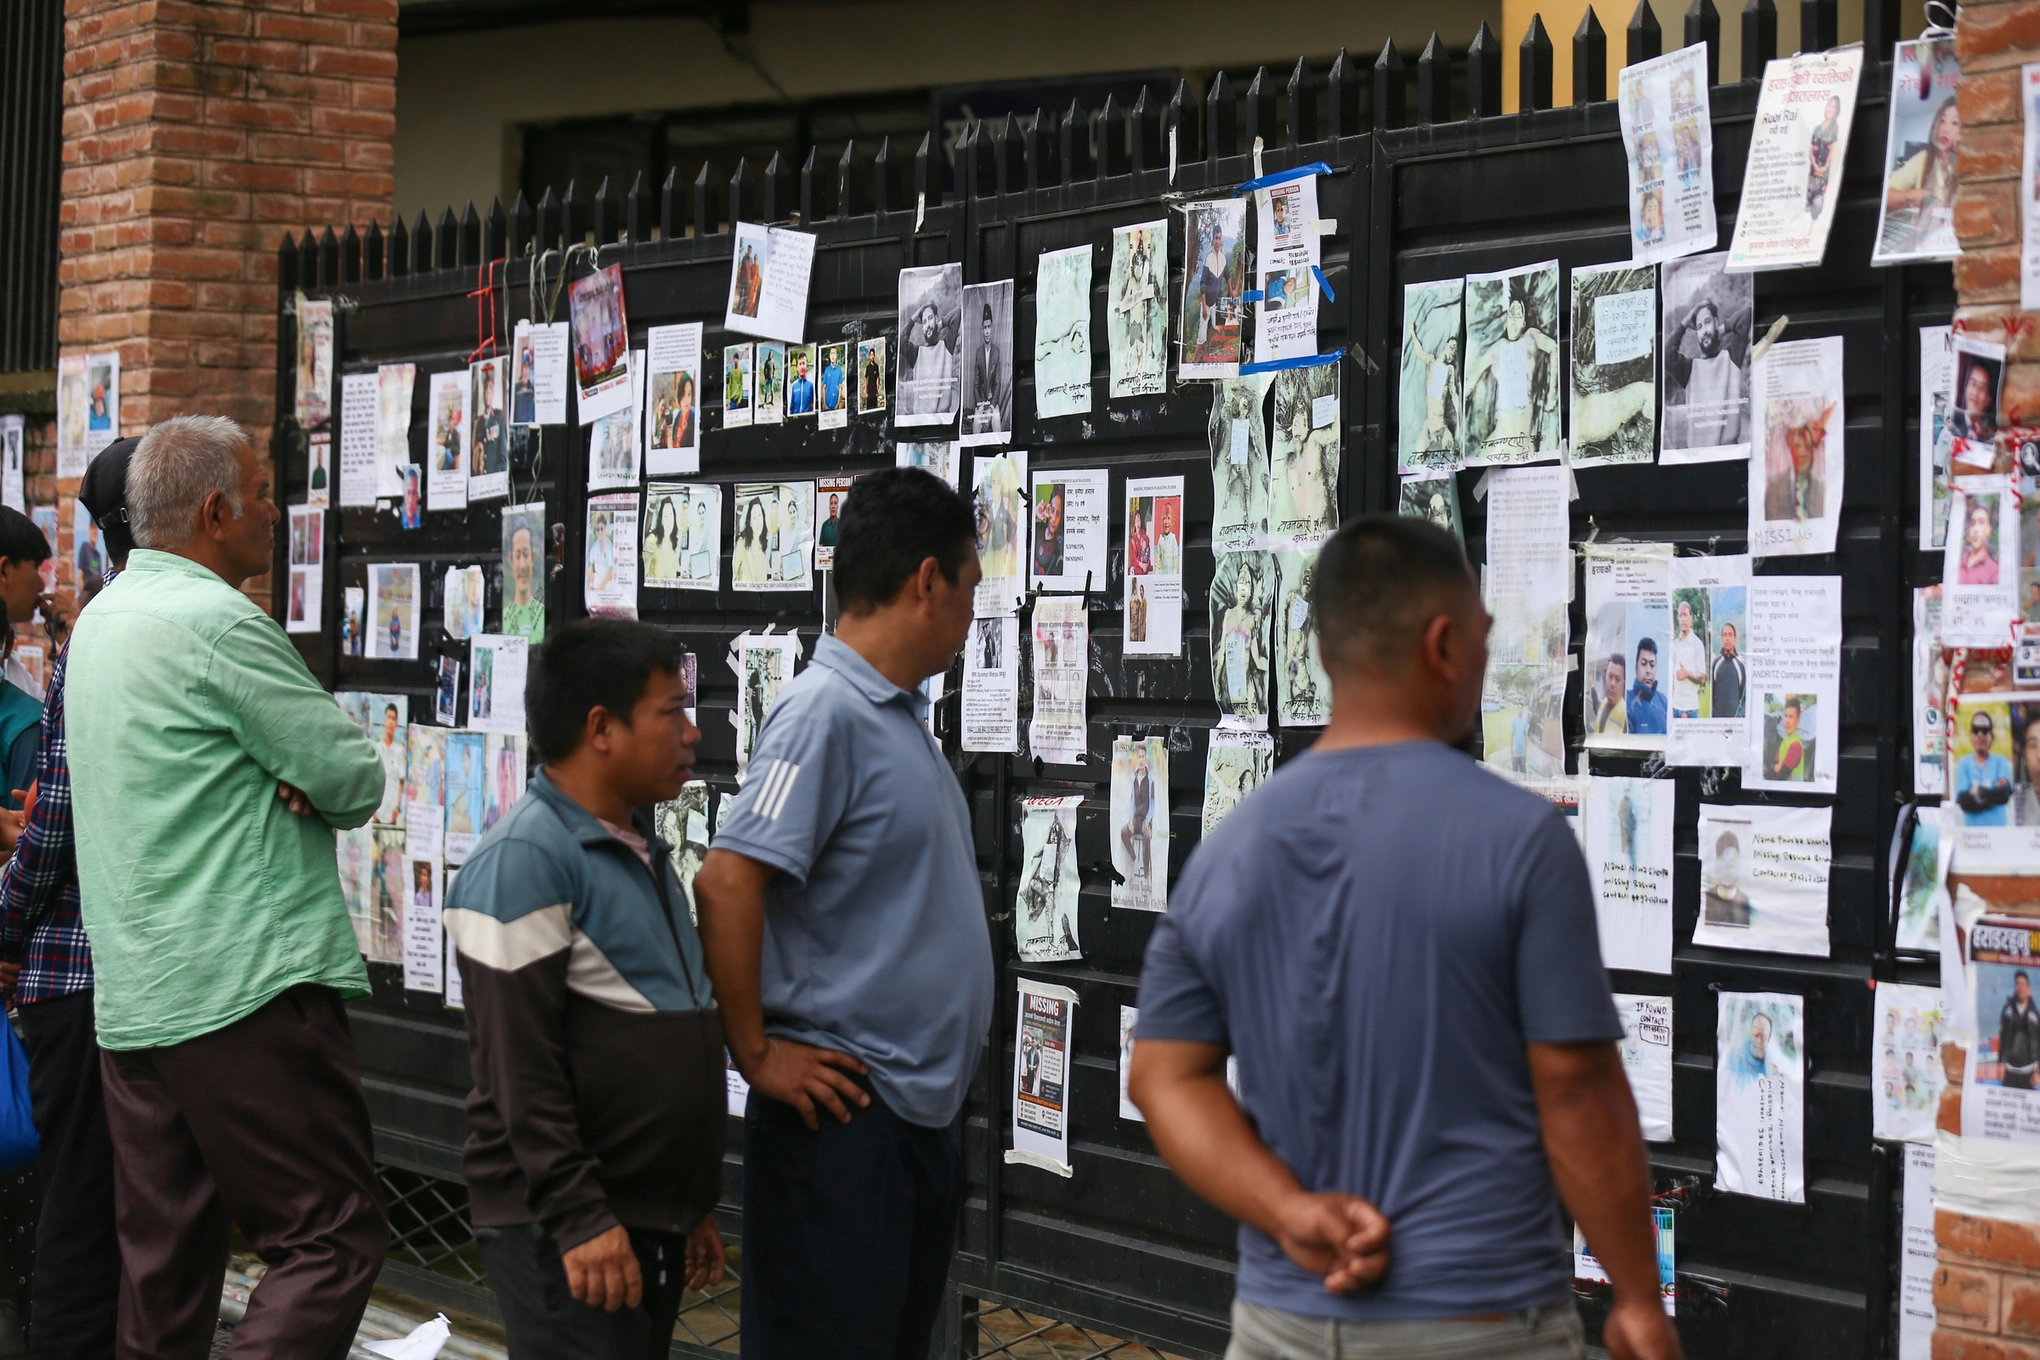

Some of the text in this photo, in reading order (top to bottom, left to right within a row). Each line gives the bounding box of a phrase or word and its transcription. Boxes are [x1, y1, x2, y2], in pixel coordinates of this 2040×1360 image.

[1783, 109, 1798, 122] Rai
[1271, 185, 1299, 196] MISSING PERSON
[819, 477, 853, 488] MISSING PERSON
[1699, 578, 1719, 586] MISSING
[1752, 657, 1763, 666] 216
[1764, 658, 1776, 666] MW
[1752, 669, 1779, 679] ANDRITZ
[1780, 670, 1807, 681] Company
[1028, 796, 1065, 806] WEGA
[1030, 994, 1060, 1017] MISSING
[1636, 1002, 1644, 1012] IF
